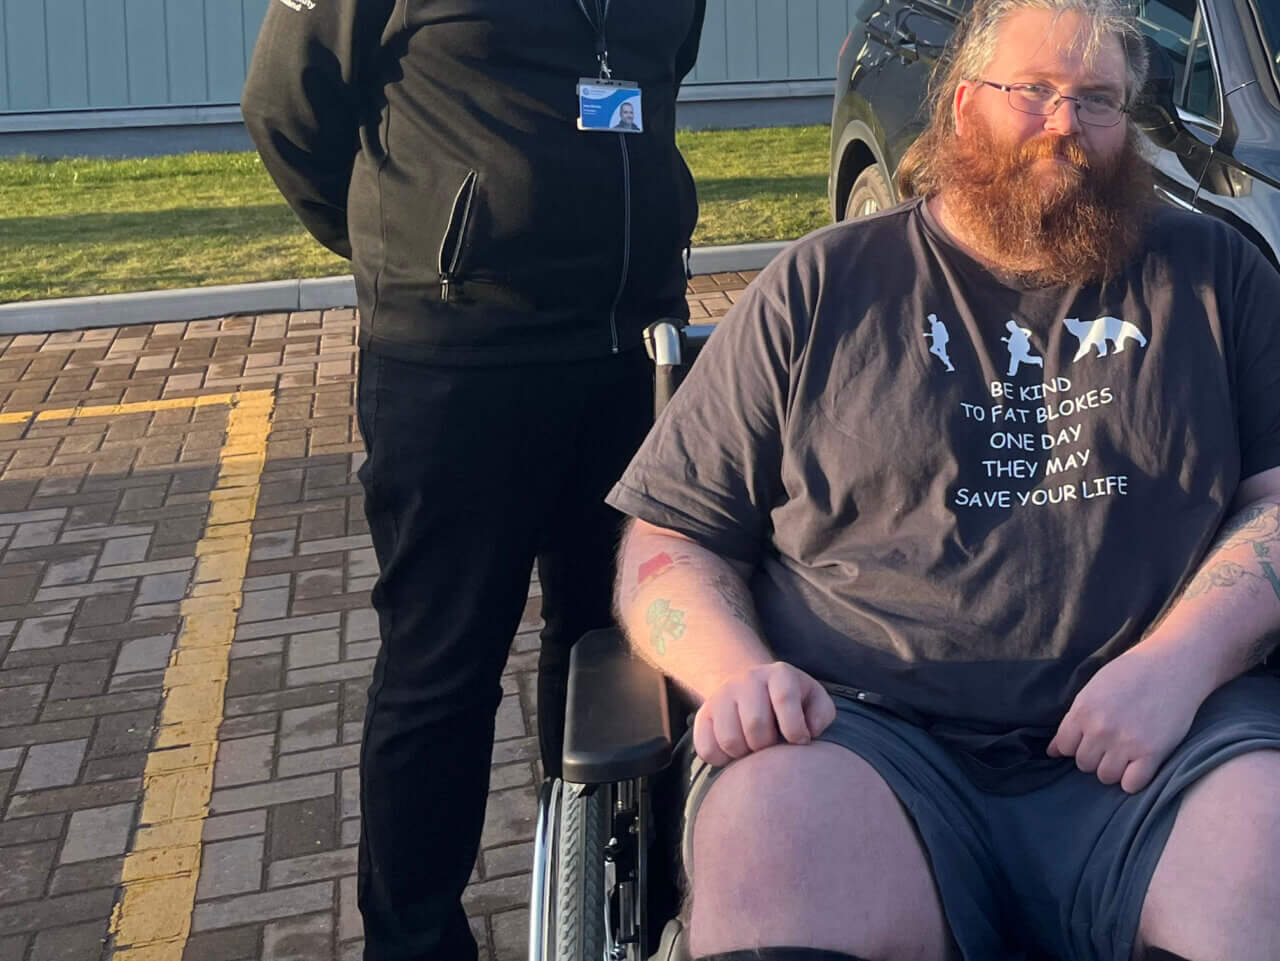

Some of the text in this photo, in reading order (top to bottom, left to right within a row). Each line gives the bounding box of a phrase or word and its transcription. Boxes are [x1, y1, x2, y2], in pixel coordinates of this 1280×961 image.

[990, 376, 1072, 401] BE KIND
[960, 387, 1113, 424] TO FAT BLOKES
[990, 424, 1082, 451] ONE DAY
[982, 449, 1090, 478] THEY MAY
[954, 476, 1128, 508] SAVE YOUR LIFE
